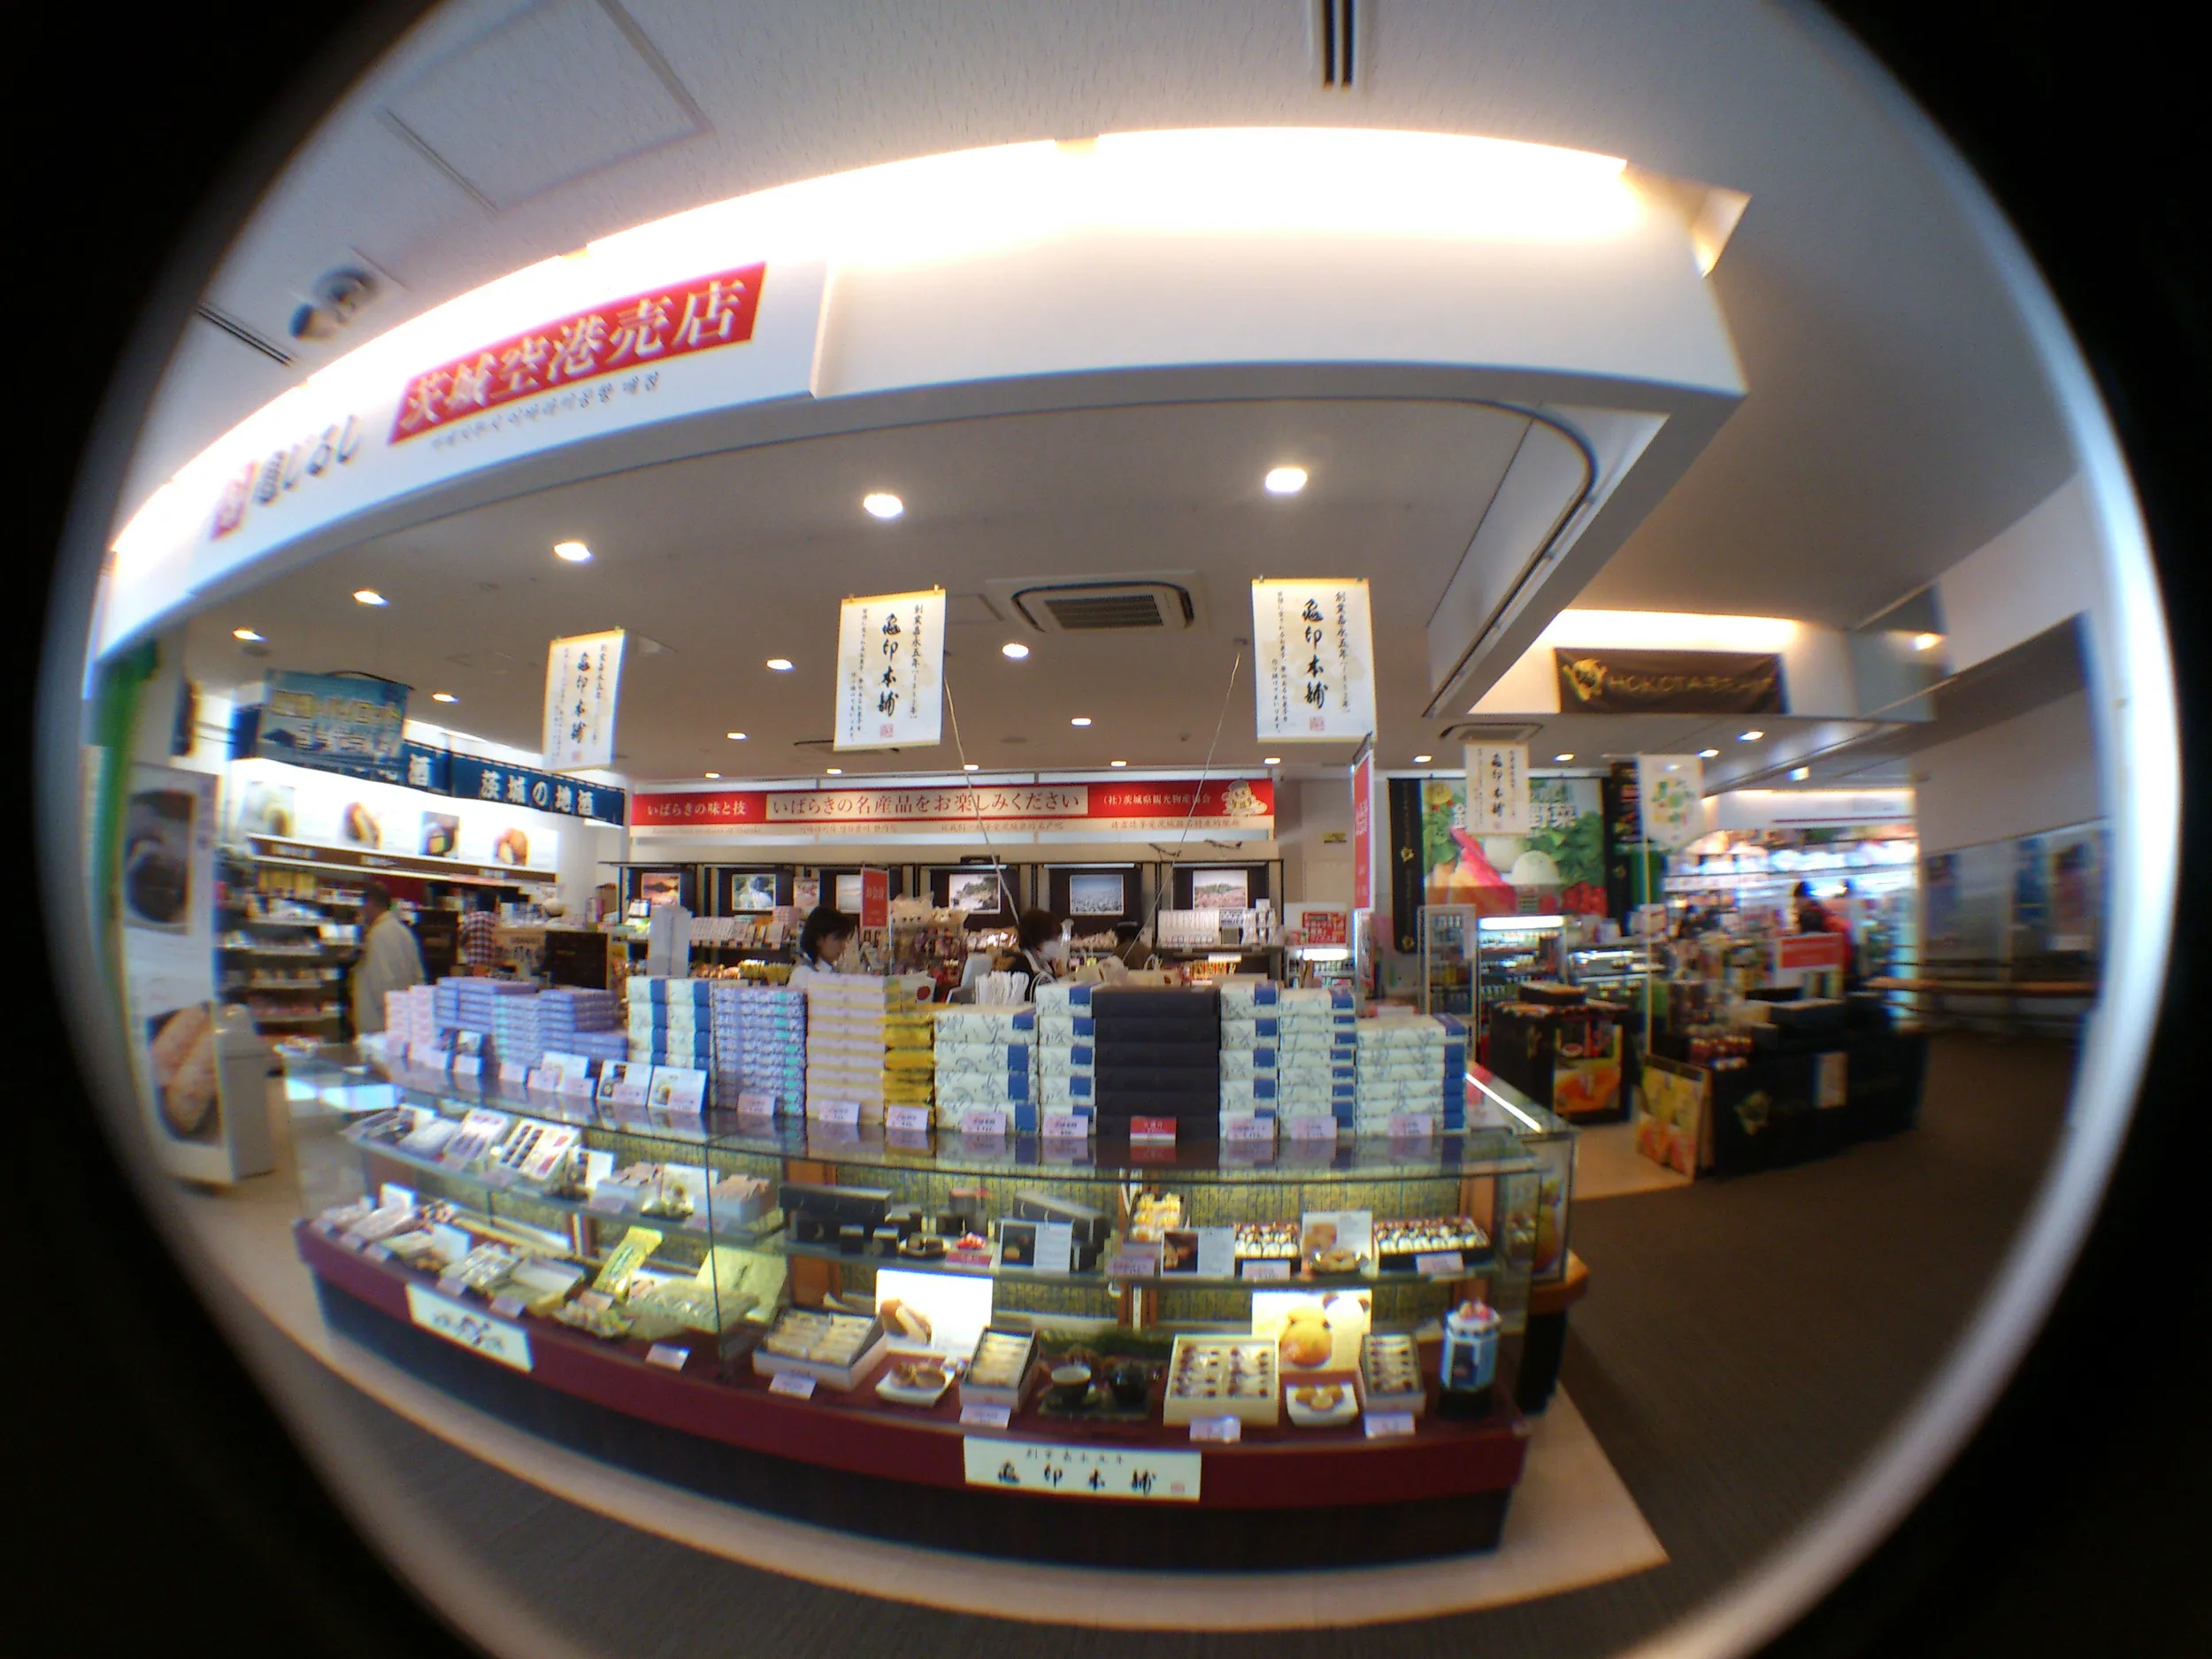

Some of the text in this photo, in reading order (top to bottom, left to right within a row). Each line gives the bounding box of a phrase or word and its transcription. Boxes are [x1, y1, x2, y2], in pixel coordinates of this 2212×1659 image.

[399, 279, 746, 432] 茨城空港売店
[480, 769, 595, 817] 茨城の地酒
[647, 799, 747, 817] いばらきの味と技
[772, 792, 1080, 815] いばらきの名産品をお楽しみください
